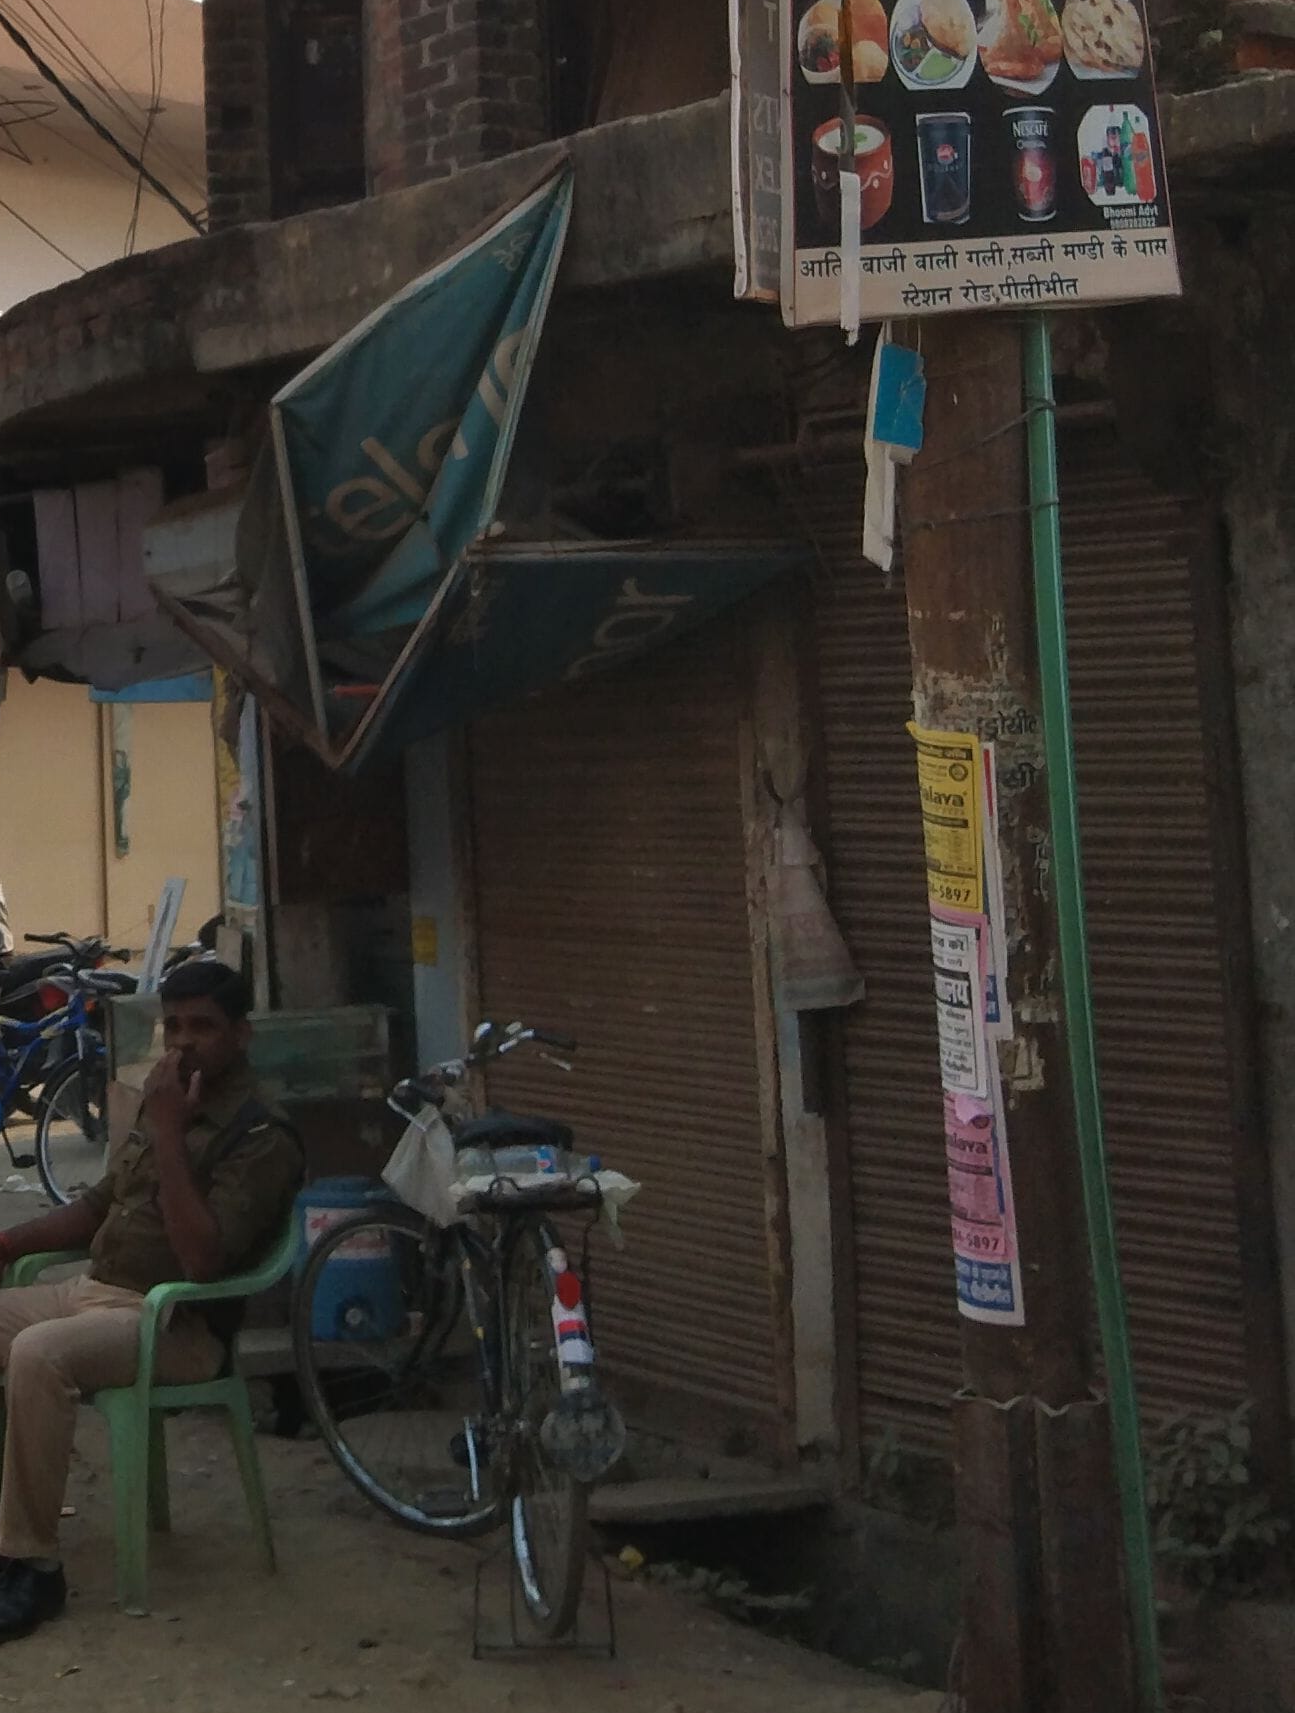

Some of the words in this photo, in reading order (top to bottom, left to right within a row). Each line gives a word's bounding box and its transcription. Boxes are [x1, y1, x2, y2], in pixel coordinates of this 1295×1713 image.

[915, 244, 958, 271] वाली
[1063, 237, 1104, 262] मण्डी
[1111, 233, 1127, 258] के
[1135, 235, 1168, 256] पास
[901, 280, 952, 308] स्टेशन
